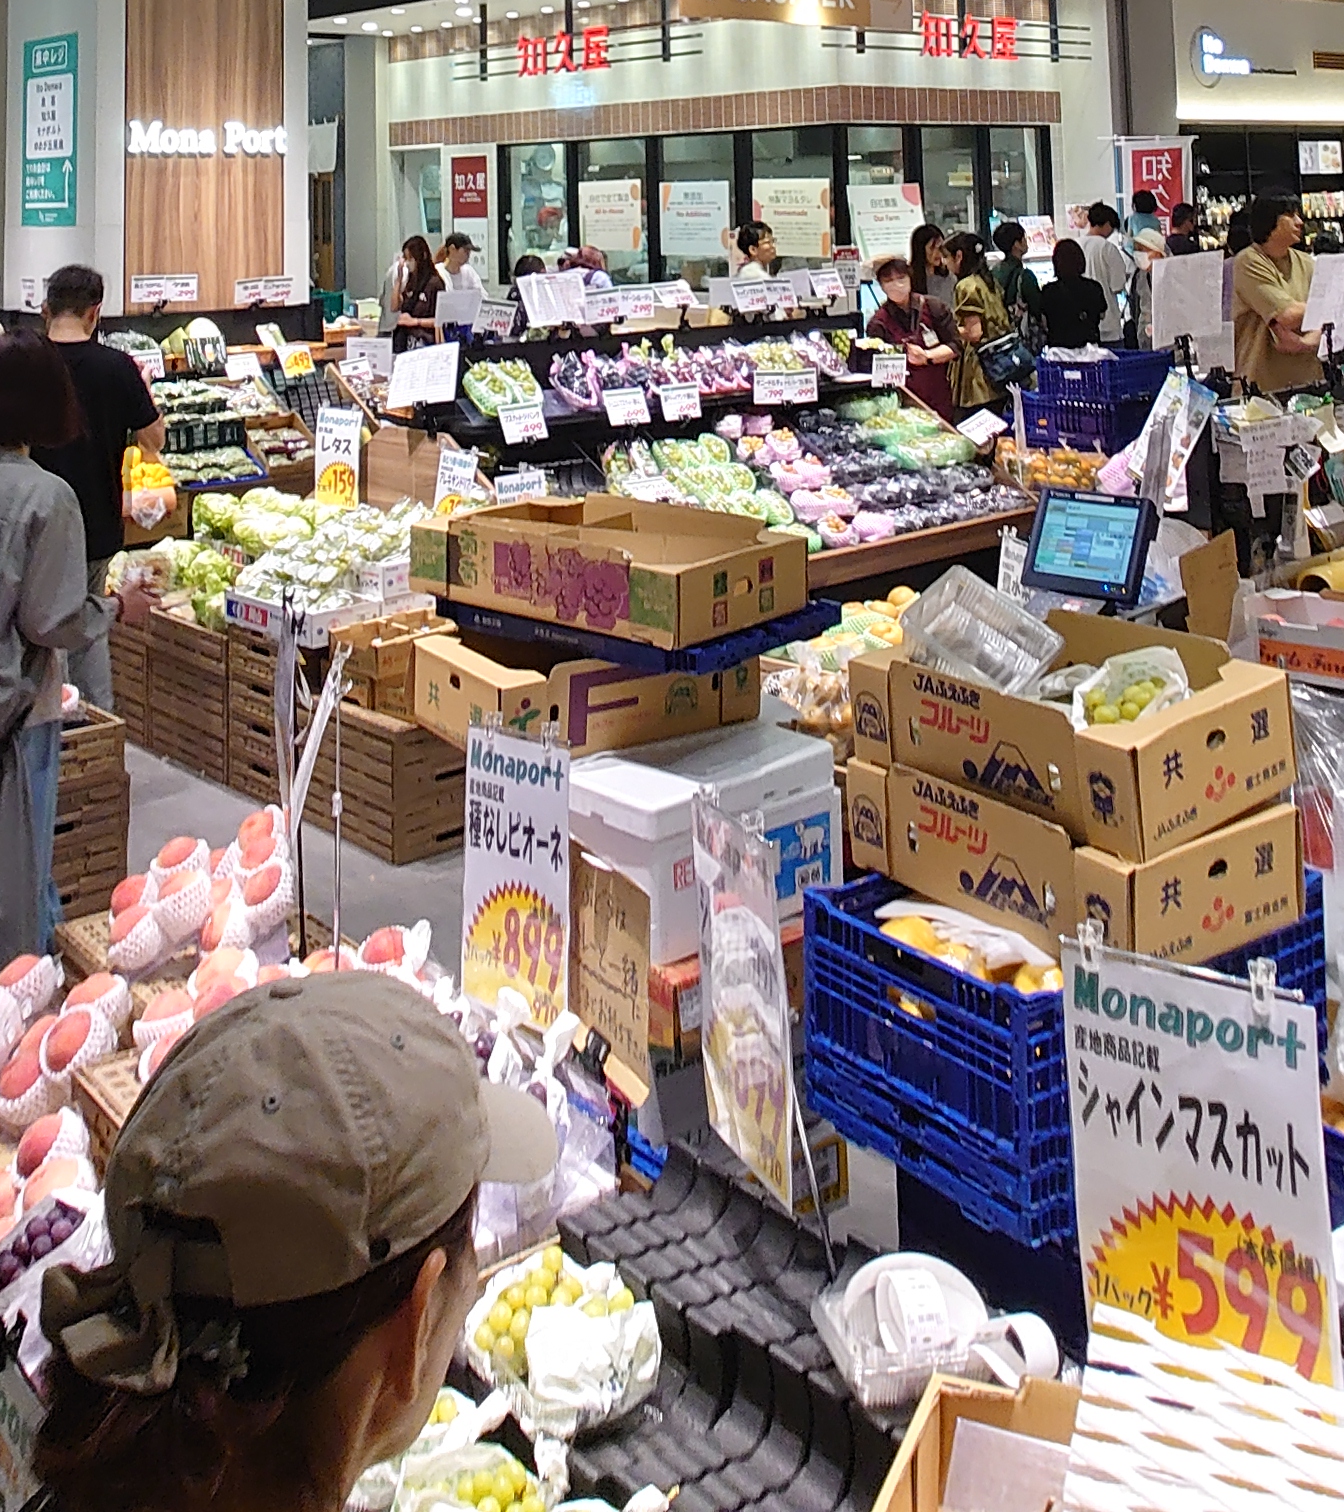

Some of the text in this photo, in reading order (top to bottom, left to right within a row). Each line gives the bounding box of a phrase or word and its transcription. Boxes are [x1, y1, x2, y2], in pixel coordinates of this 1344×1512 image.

[517, 25, 611, 77] 知久屋
[920, 10, 1019, 60] 知久屋
[128, 120, 288, 155] Mona Port
[455, 172, 486, 191] 知久屋
[321, 435, 352, 455] レタス
[498, 479, 542, 494] Monaport
[470, 738, 564, 791] Monaport
[468, 799, 564, 873] 種なしピオーネ
[1073, 966, 1306, 1071] Monaport
[1074, 1025, 1161, 1074] 産地商品記載
[1077, 1058, 1310, 1197] シャインマスカット
